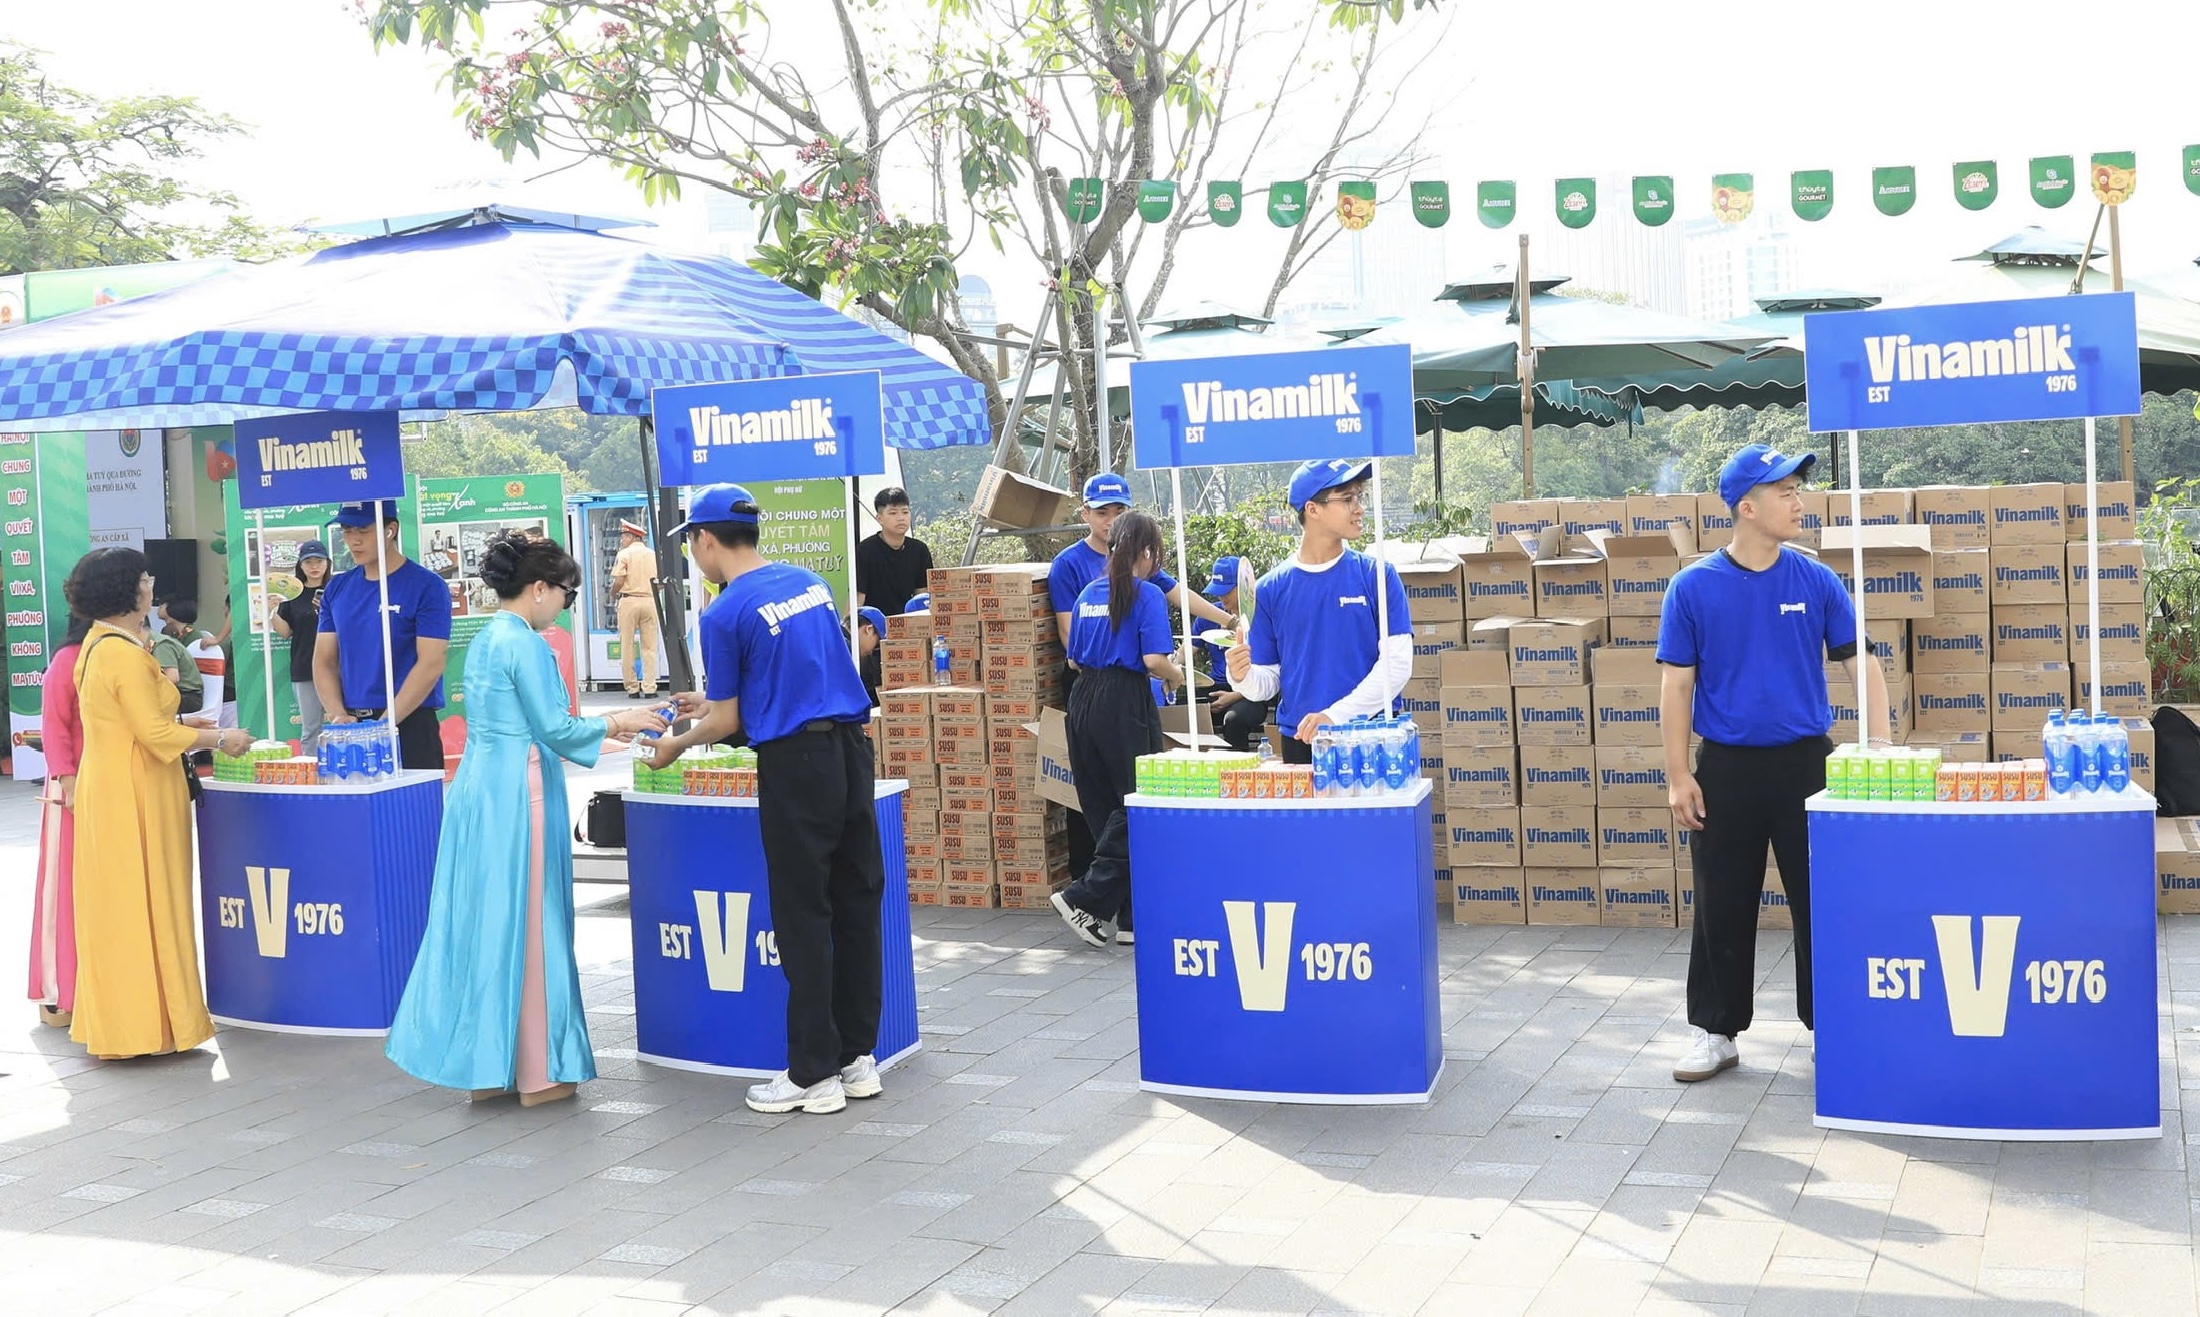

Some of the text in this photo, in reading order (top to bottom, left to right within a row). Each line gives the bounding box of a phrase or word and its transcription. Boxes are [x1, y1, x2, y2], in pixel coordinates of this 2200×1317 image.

[1864, 324, 2076, 383] Vinamilk
[1868, 375, 2076, 403] EST 1976
[1182, 374, 1361, 424] Vinamilk
[689, 398, 836, 446] Vinamilk
[1185, 417, 1362, 443] EST 1976
[258, 430, 365, 472] Vinamilk
[693, 442, 837, 463] EST 1976
[2, 461, 30, 472] CHUNG
[261, 468, 367, 486] EST 1976
[9, 488, 26, 504] MỘT
[1995, 507, 2060, 522] Vinamilk
[2068, 503, 2129, 518] Vinmilk
[758, 508, 845, 524] ỘI CHUNG MỘT
[1922, 510, 1986, 525] Vinamilk
[7, 518, 32, 534] QUYẾT
[759, 522, 830, 539] UYẾT TÂM
[782, 542, 830, 553] PHƯỜNG
[13, 550, 29, 564] TÂM
[931, 571, 946, 580] SUSU
[1996, 566, 2060, 581] Vinamilk
[2073, 565, 2138, 580] Viamilk
[975, 574, 991, 583] SUSU
[1469, 581, 1528, 596] Vinamilk
[1542, 581, 1603, 596] Vinamilk
[982, 598, 999, 608] SUSU
[1910, 594, 1923, 602] 1976
[938, 603, 952, 611] SUSU
[8, 612, 42, 625] PHƯỜNG
[889, 618, 904, 627] SUSU
[935, 616, 950, 626] SUSU
[988, 622, 1005, 631] SUSU
[2075, 624, 2140, 638] Viamilk
[1998, 625, 2062, 639] Vinamilk
[1918, 634, 1983, 650] Vinamilk
[12, 642, 40, 654] KHÔNG
[888, 651, 902, 659] SUSU
[1515, 646, 1578, 662] Vinamilk
[991, 657, 1007, 665] SUSU
[890, 674, 904, 682] SUSU
[989, 669, 1006, 679] SUSU
[13, 675, 25, 685] MA
[1920, 694, 1986, 709] Vinamilk
[1998, 693, 2065, 708] Vinamilk
[888, 704, 904, 712] SUSU
[939, 704, 955, 712] SUSU
[994, 704, 1009, 713] SUSU
[1446, 707, 1508, 721] Vinamilk
[1521, 707, 1585, 722] Vinamilk
[889, 727, 904, 736] SUSU
[942, 727, 958, 736] SUSU
[996, 729, 1012, 737] SUSU
[939, 741, 955, 751] SUSU
[994, 742, 1010, 752] SUSU
[891, 752, 906, 761] SUSU
[889, 766, 906, 775] SUSU
[995, 767, 1012, 776] SUSU
[1448, 767, 1510, 782] Vinamilk
[1526, 768, 1590, 782] Vinamilk
[2004, 771, 2020, 780] SUSU
[2026, 771, 2042, 780] SUSU
[949, 776, 965, 785] SUSU
[1220, 772, 1234, 780] SUSU
[1239, 772, 1251, 780] SUSU
[1257, 772, 1270, 780] SUSU
[1275, 772, 1288, 780] SUSU
[1294, 772, 1307, 780] SUSU
[1602, 769, 1666, 784] Vinamilk
[1939, 772, 1954, 780] SUSU
[1960, 772, 1975, 780] SUSU
[1982, 772, 1998, 780] SUSU
[999, 790, 1016, 800] SUSU
[950, 800, 966, 809] SUSU
[944, 814, 960, 823] SUSU
[996, 816, 1013, 826] SUSU
[1453, 828, 1514, 842] Vinamilk
[1527, 828, 1590, 843] Vinamilk
[1603, 829, 1668, 843] Vinamilk
[945, 837, 961, 847] SUSU
[998, 838, 1015, 848] SUSU
[952, 871, 967, 880] SUSU
[1005, 873, 1021, 882] SUSU
[1004, 886, 1022, 896] SUSU
[1458, 886, 1520, 900] Vinamilk
[1533, 886, 1596, 900] Vinamilk
[950, 896, 966, 904] SUSU
[1605, 889, 1670, 904] Vinamilk
[219, 866, 344, 958] EST V 1976
[659, 890, 781, 992] EST V 19
[1173, 900, 1372, 1012] EST V 1976
[1867, 915, 2107, 1037] EST V 1976
